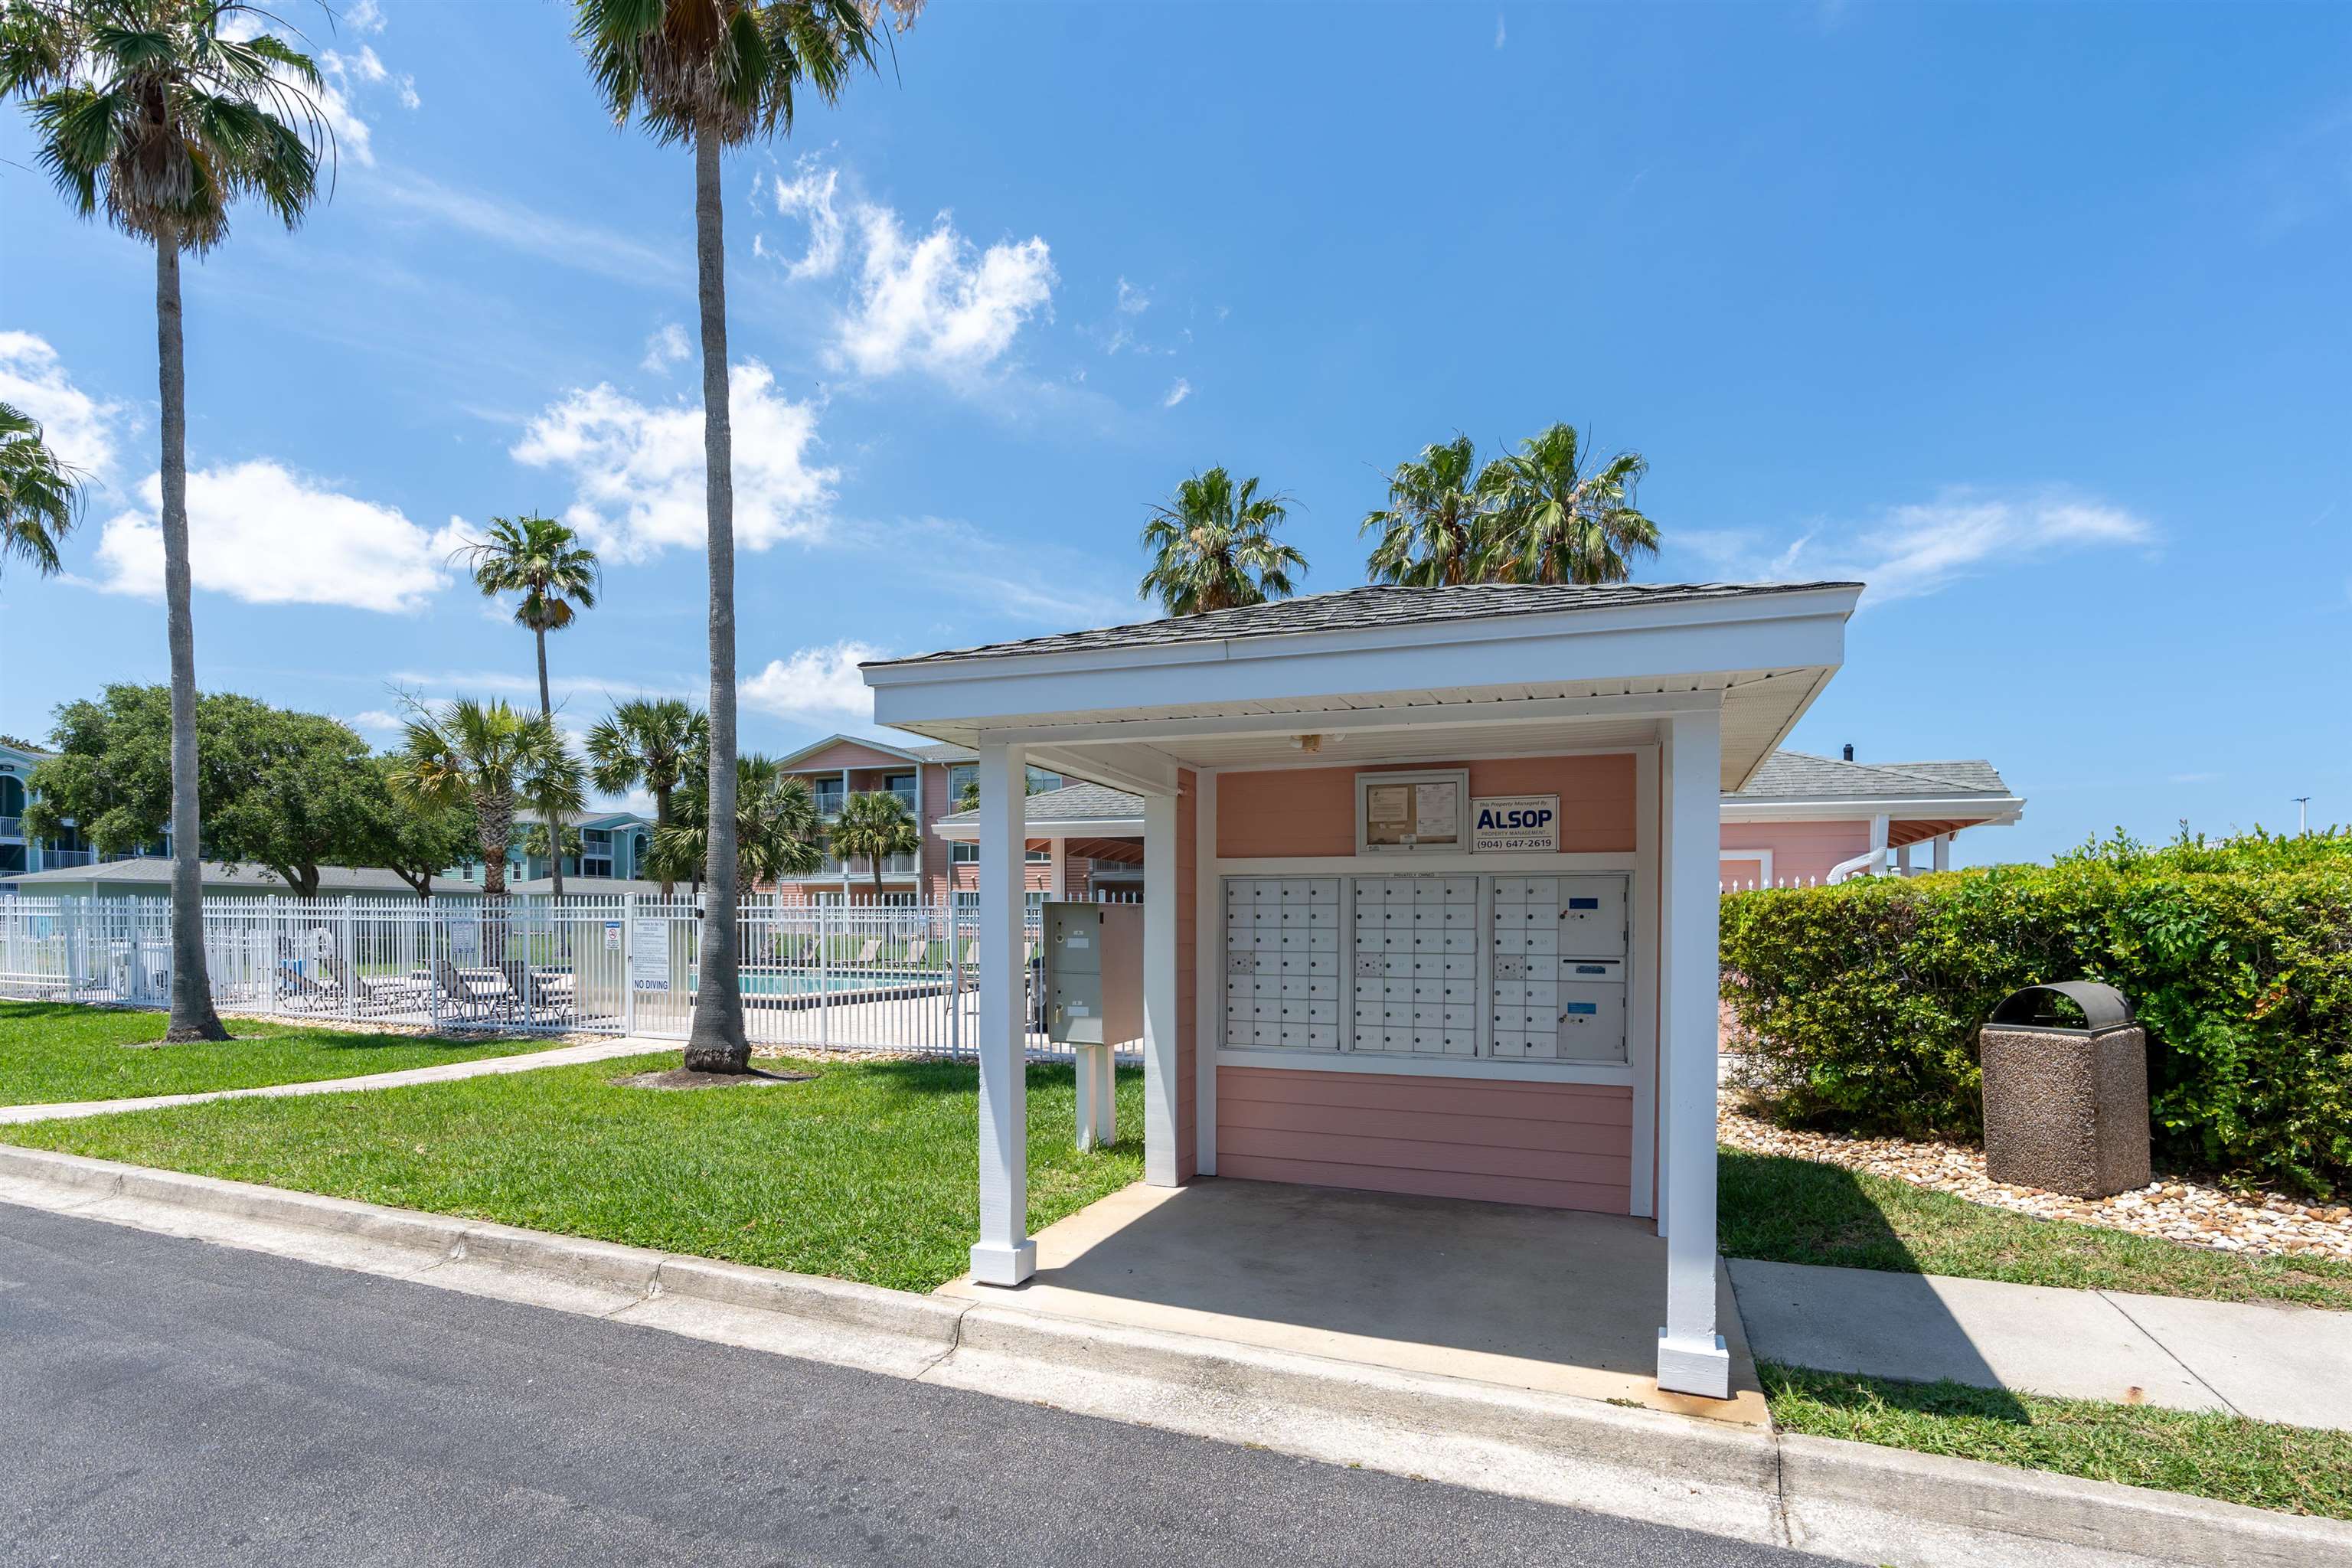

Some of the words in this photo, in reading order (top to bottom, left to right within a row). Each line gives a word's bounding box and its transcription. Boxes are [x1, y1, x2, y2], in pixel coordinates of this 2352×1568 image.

[1477, 808, 1552, 829] ALSOP
[1477, 840, 1503, 849] (904)
[1506, 839, 1551, 848] 647-2619
[635, 980, 644, 988] NO
[645, 980, 668, 989] DIVING
